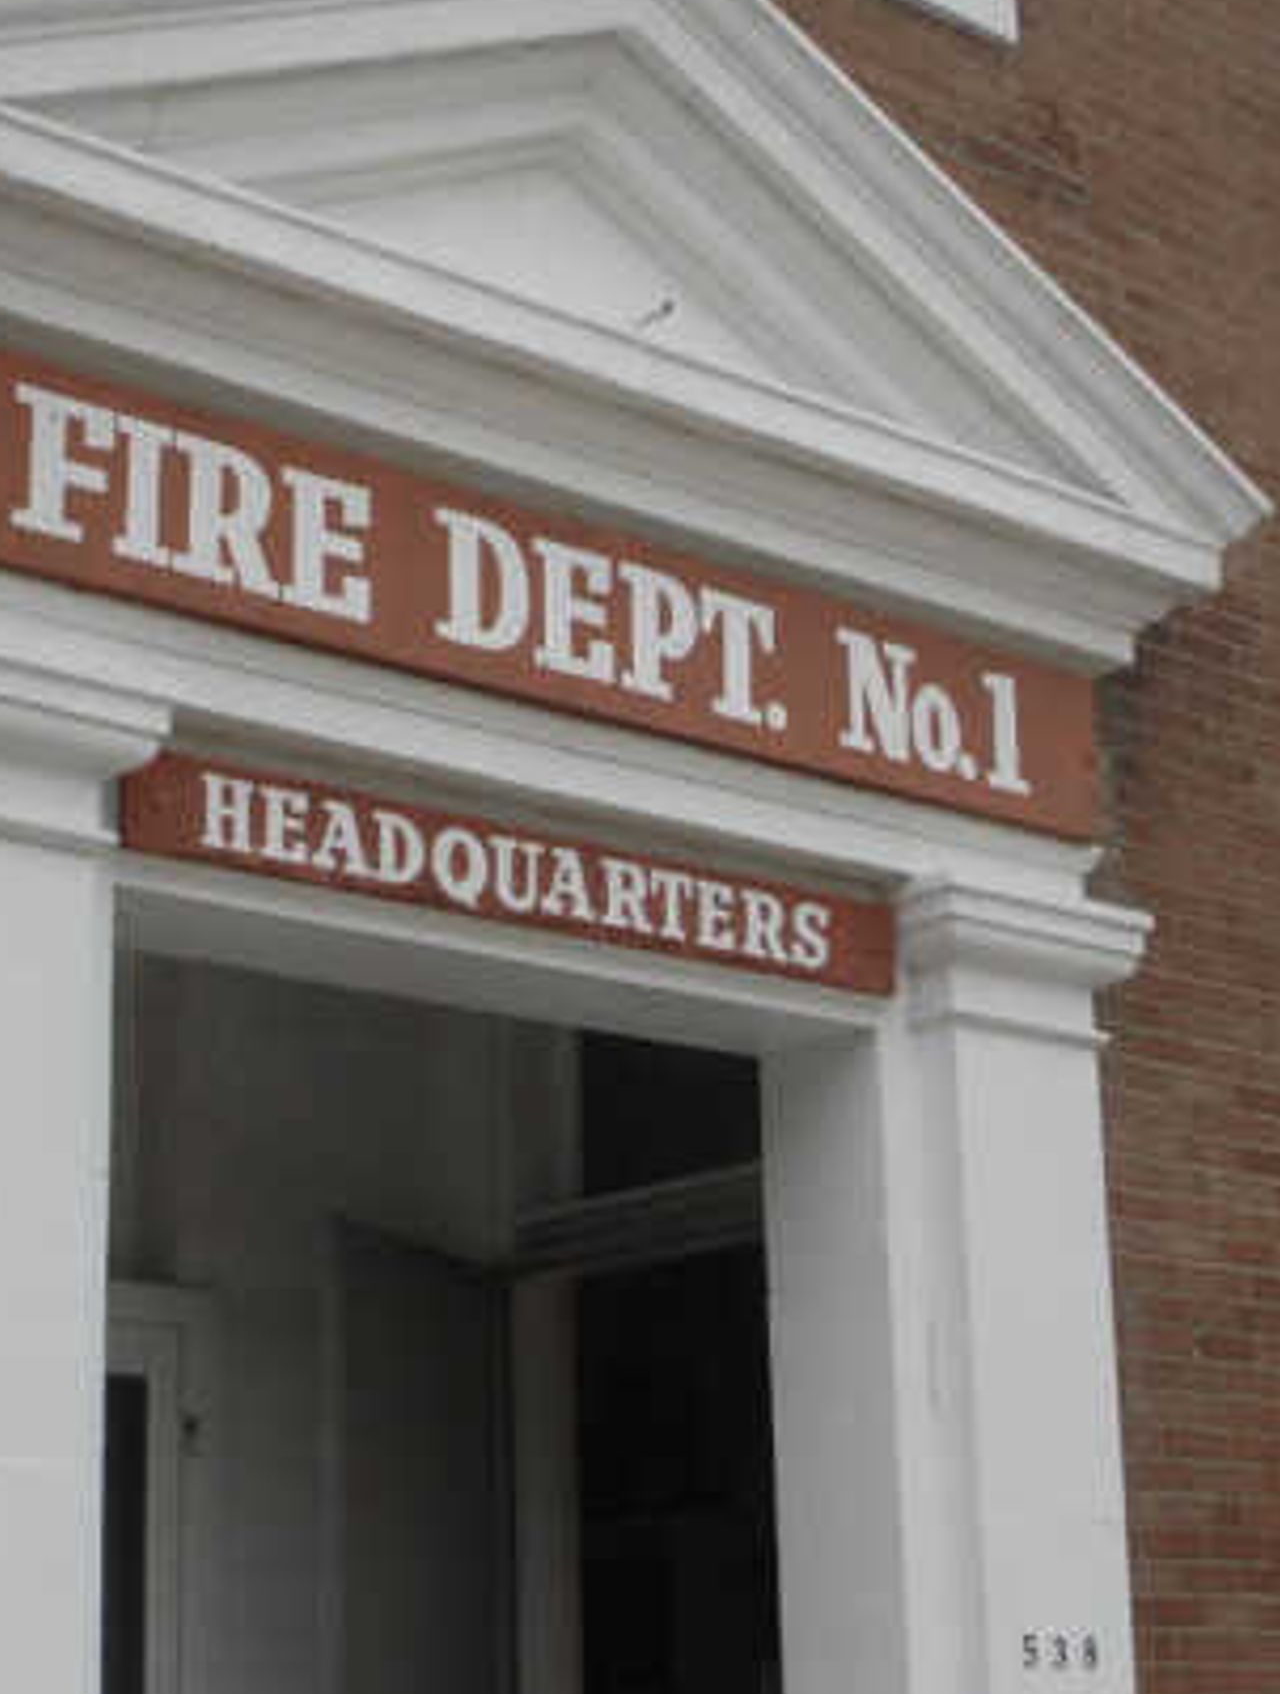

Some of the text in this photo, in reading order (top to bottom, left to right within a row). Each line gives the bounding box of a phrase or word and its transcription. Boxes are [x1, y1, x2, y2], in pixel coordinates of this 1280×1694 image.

[9, 382, 1033, 796] FIRE DEPT. No.1
[200, 772, 832, 971] HEADQUARTERS
